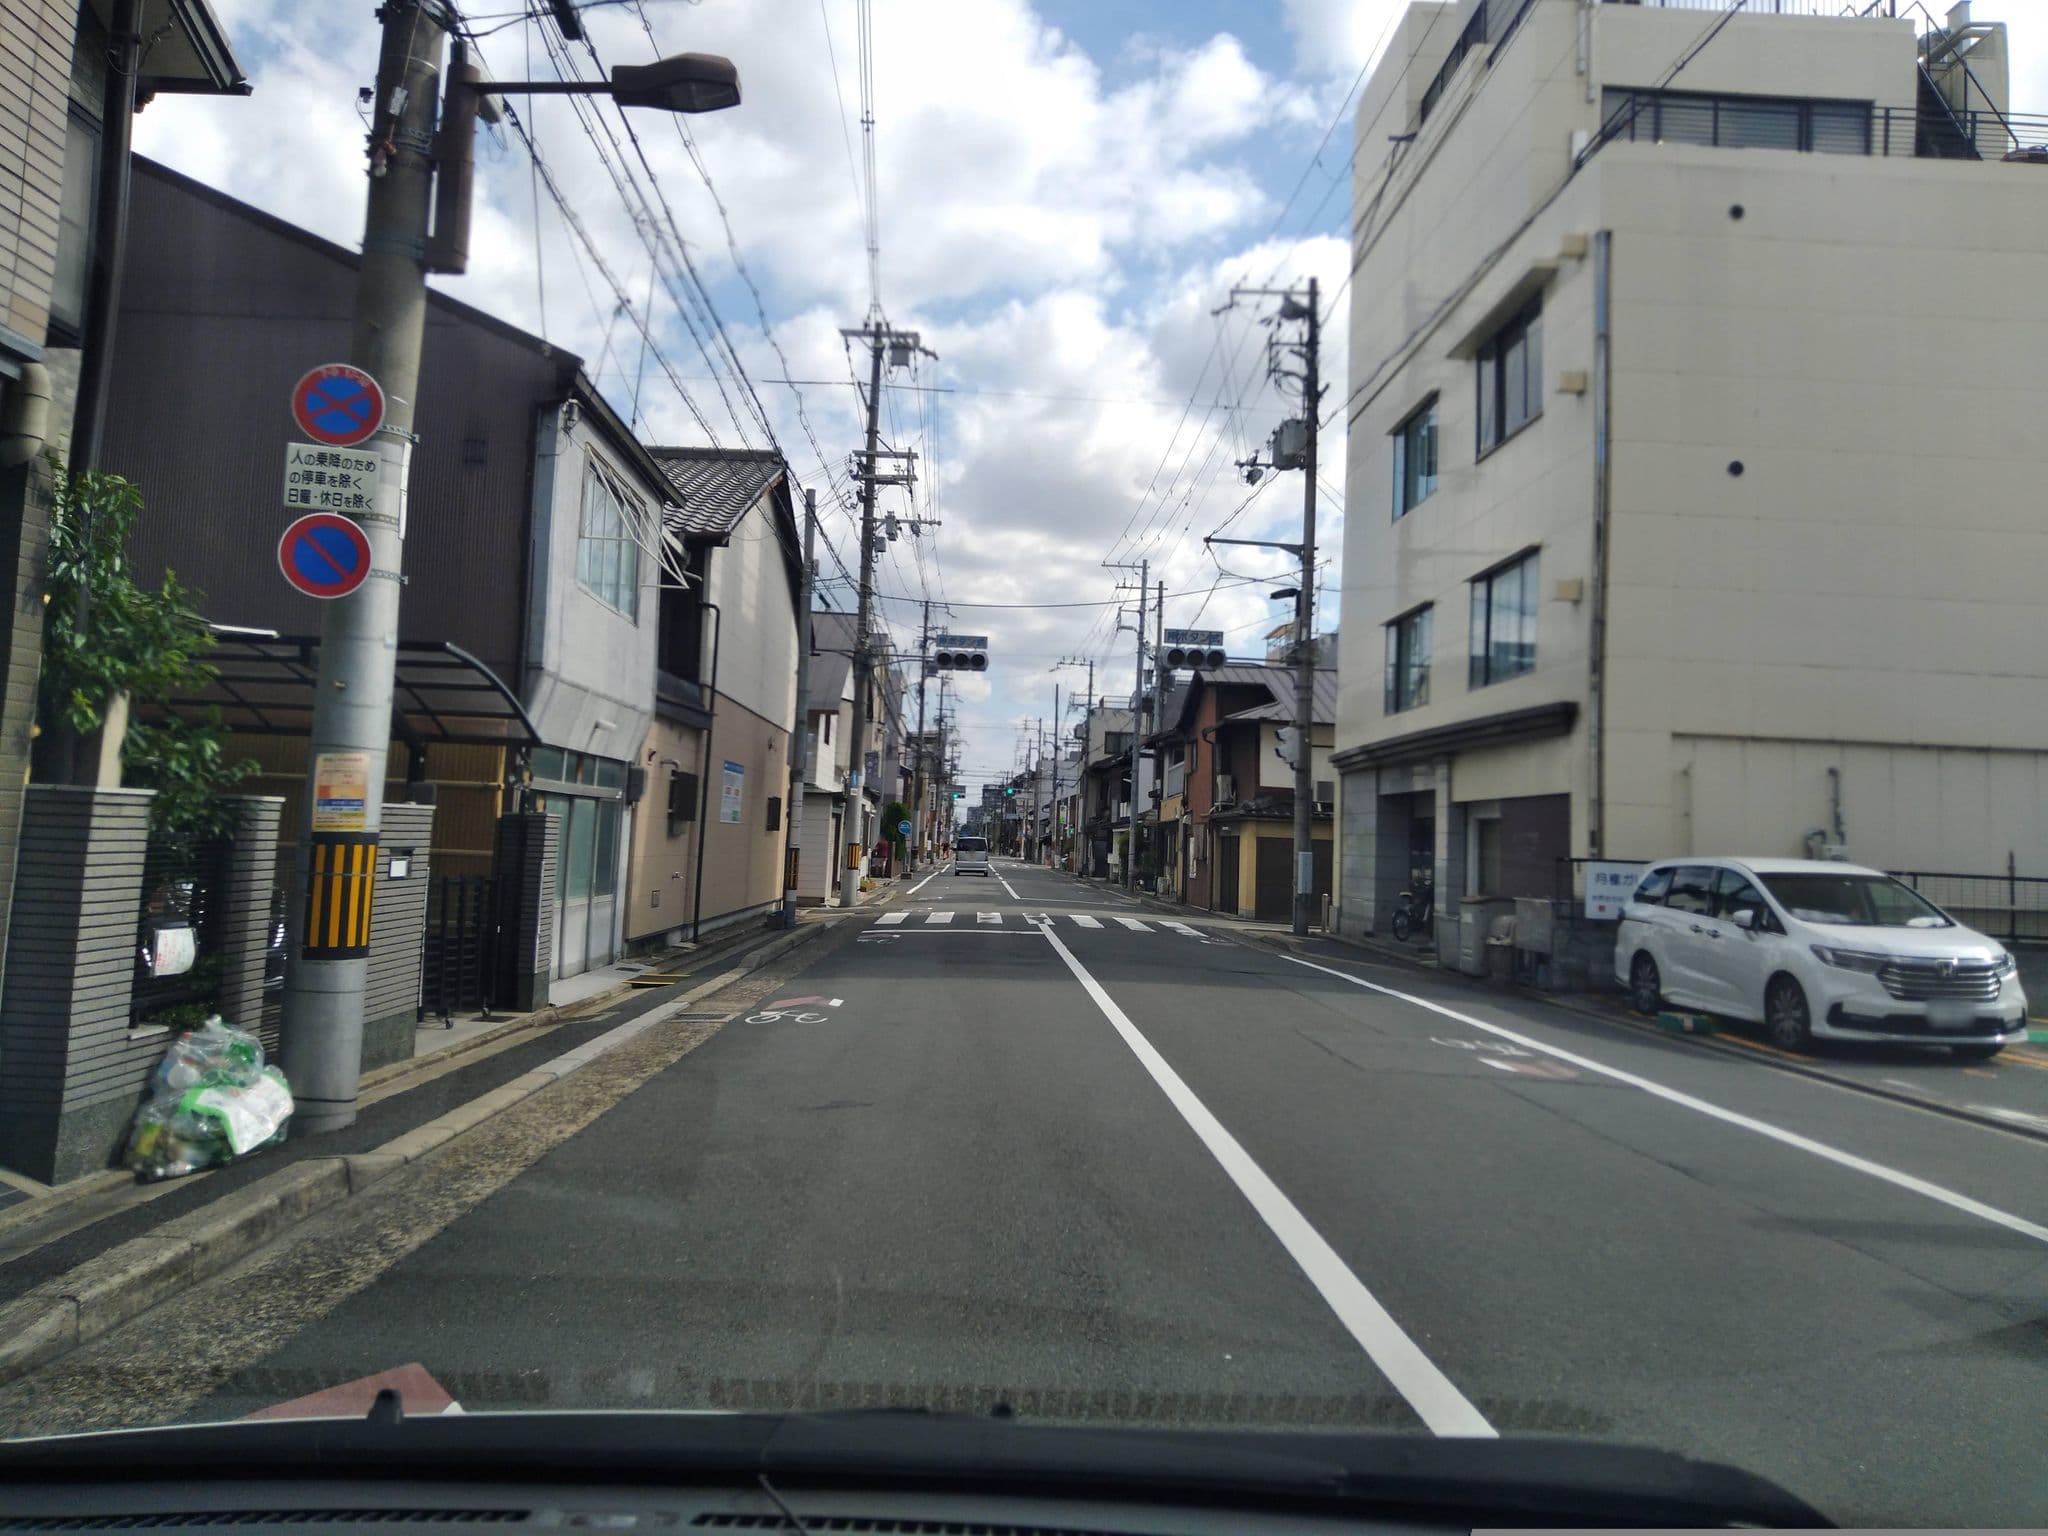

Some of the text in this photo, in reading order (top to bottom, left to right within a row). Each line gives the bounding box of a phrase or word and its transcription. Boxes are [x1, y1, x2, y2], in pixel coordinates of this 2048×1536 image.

[290, 450, 376, 472] 人の乗降のため
[289, 470, 362, 490] の停車を除く
[288, 488, 373, 510] 日曜・休日を除く
